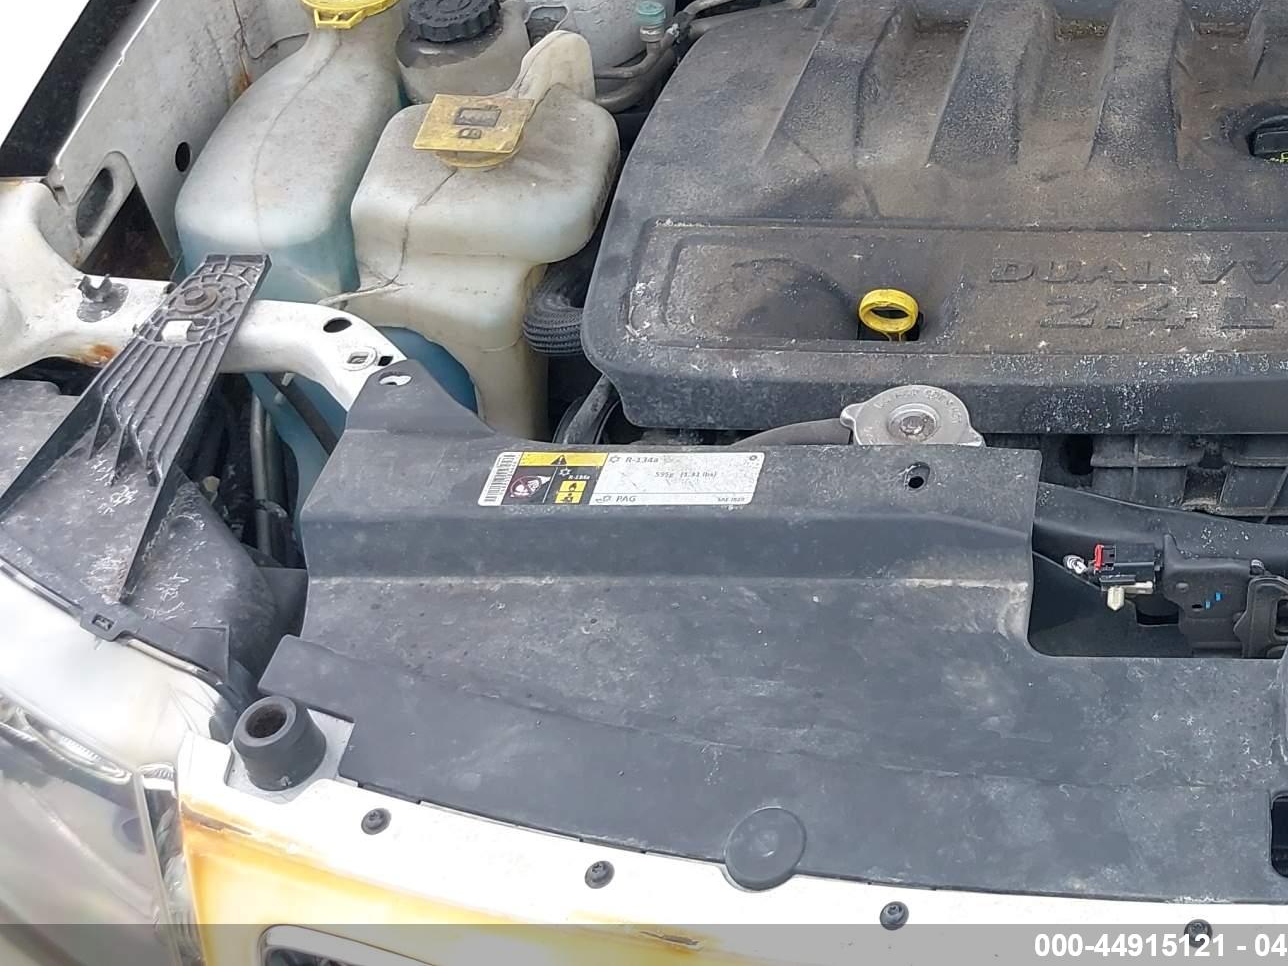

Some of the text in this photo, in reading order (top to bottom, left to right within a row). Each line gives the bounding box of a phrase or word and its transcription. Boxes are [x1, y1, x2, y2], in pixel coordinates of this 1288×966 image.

[989, 258, 1172, 284] DUAL
[625, 456, 659, 464] R-134a
[616, 495, 637, 503] PAG
